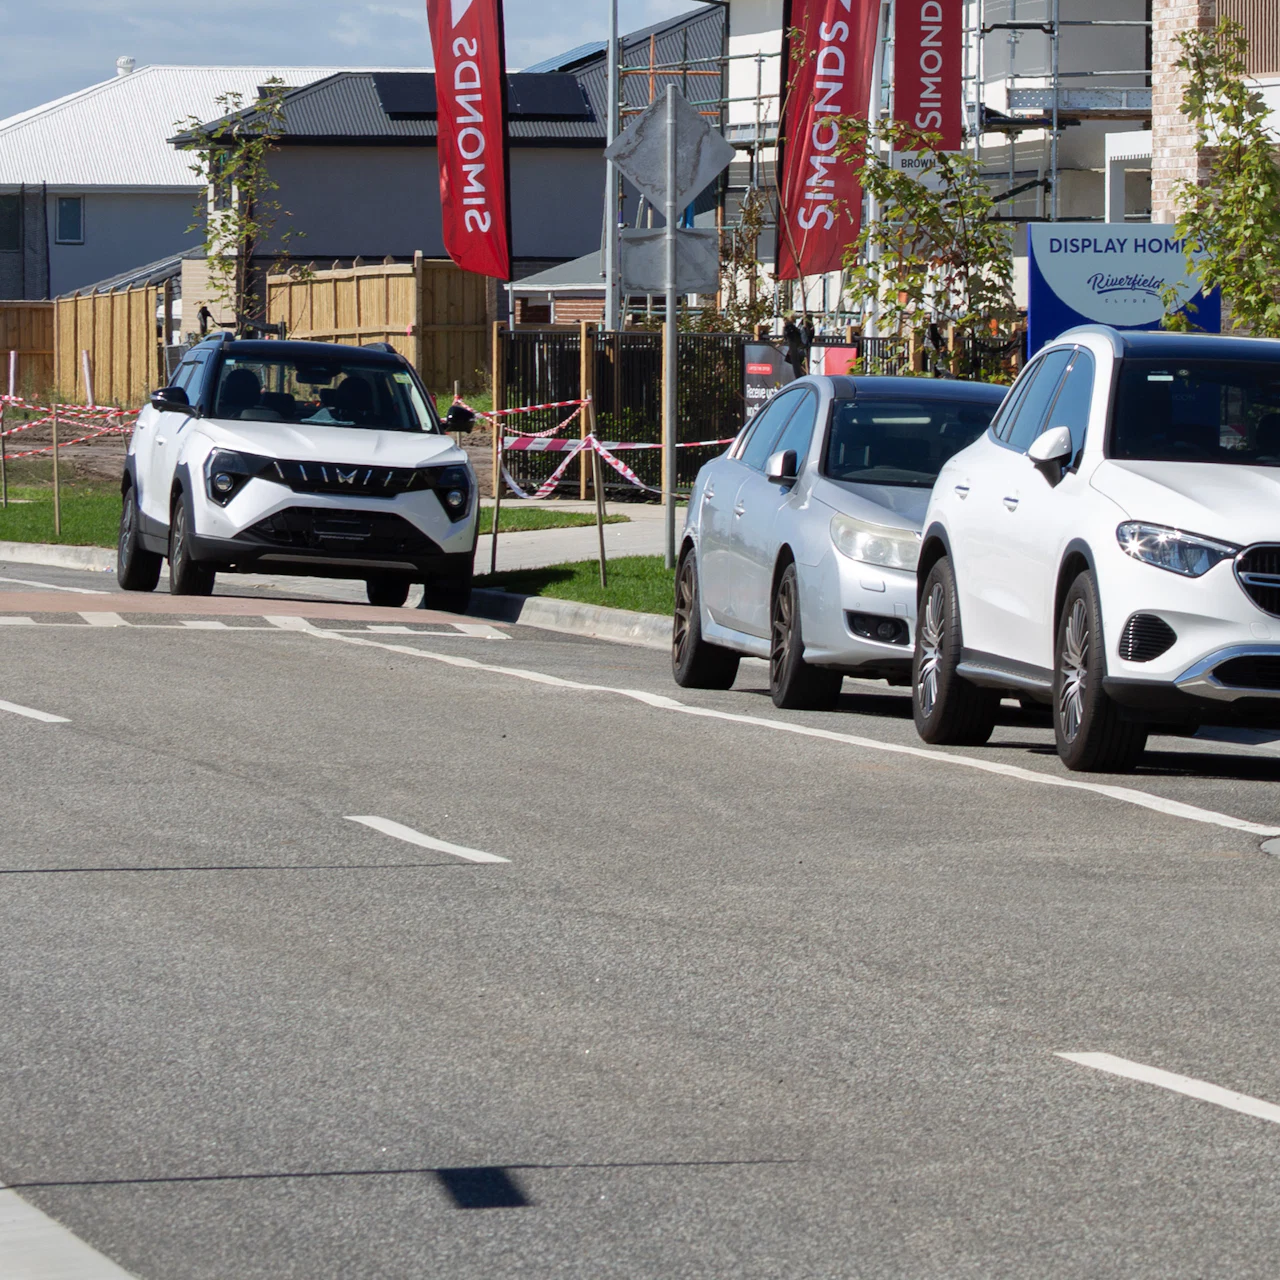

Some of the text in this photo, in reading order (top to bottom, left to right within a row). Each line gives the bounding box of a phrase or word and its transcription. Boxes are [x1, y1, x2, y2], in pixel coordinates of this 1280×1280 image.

[797, 21, 849, 230] SIMONDS
[1050, 238, 1128, 253] DISPLAY
[1087, 273, 1165, 293] Riverfield
